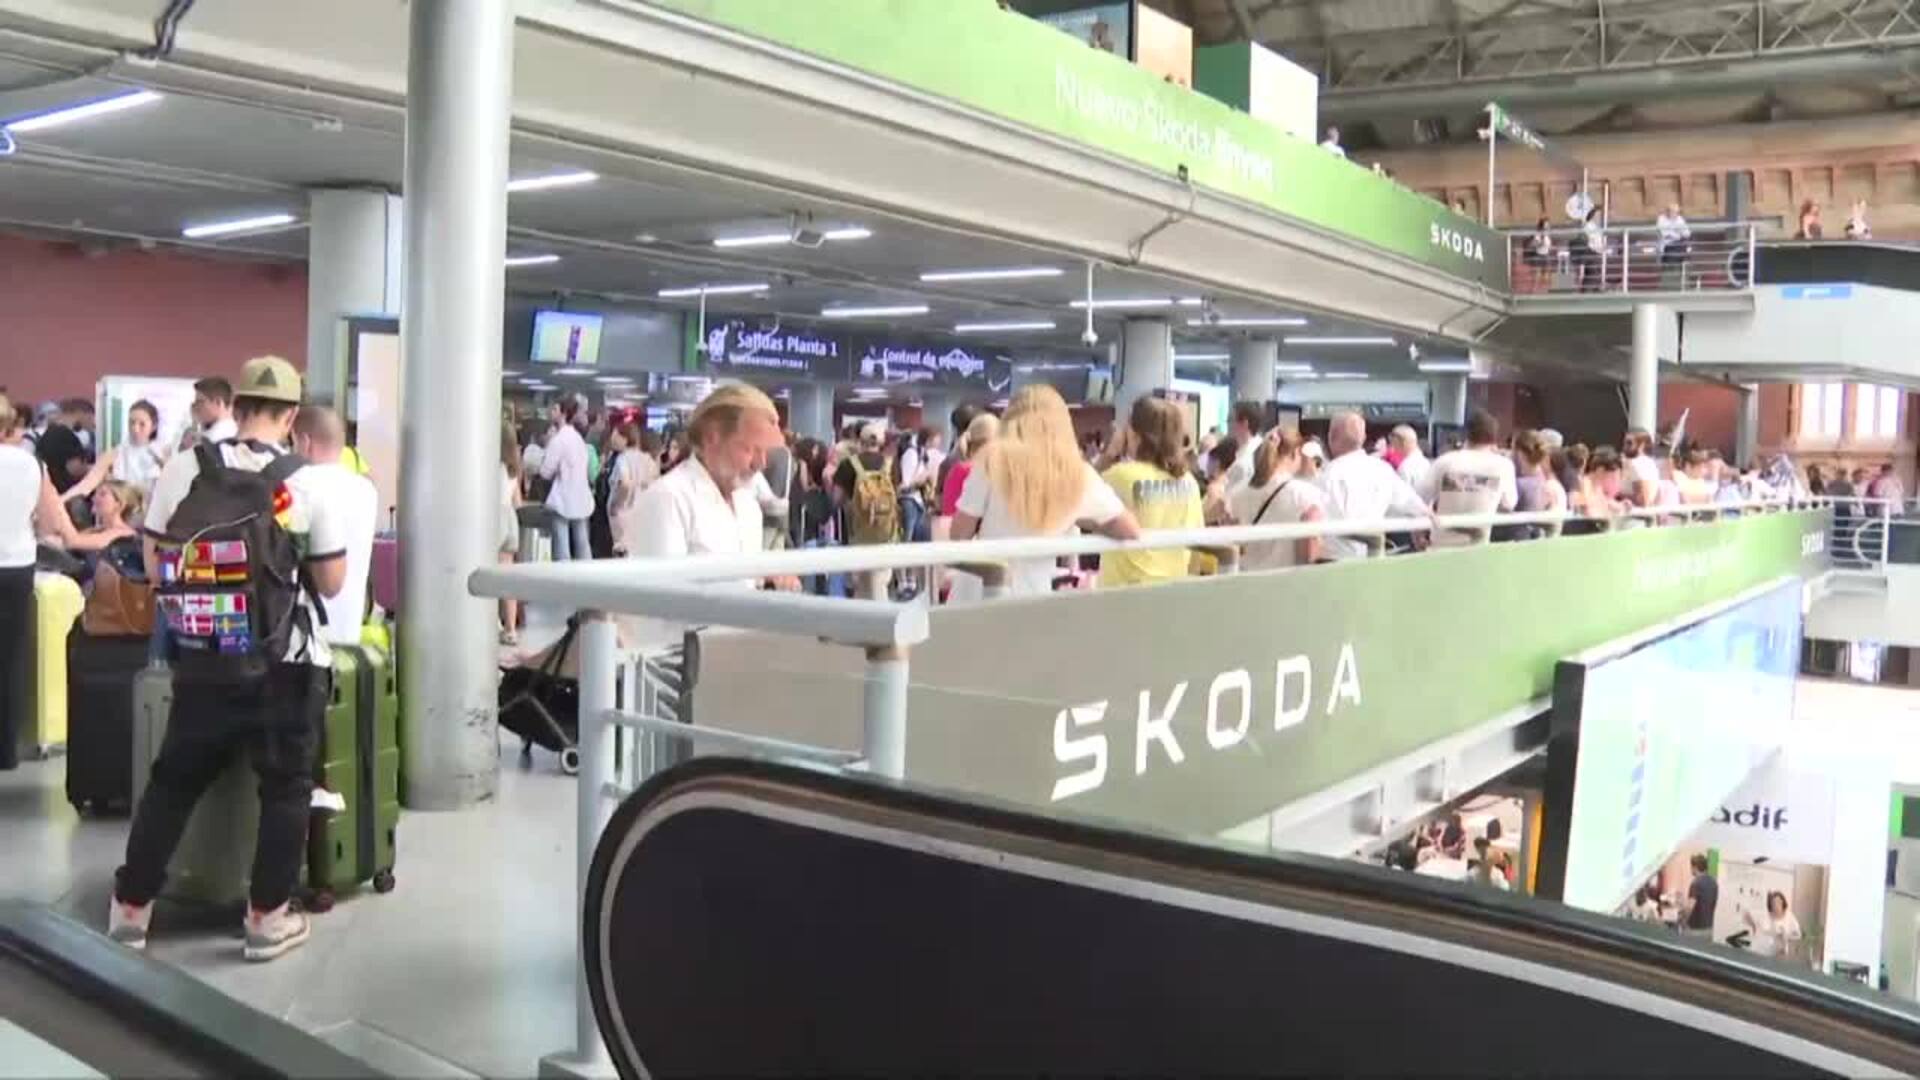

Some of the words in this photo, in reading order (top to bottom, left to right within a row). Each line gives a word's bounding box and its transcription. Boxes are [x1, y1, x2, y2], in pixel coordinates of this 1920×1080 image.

[737, 330, 783, 351] Salidas
[787, 336, 827, 356] Planta
[831, 341, 838, 357] 1
[882, 348, 921, 365] Control
[1710, 803, 1788, 830] adif
